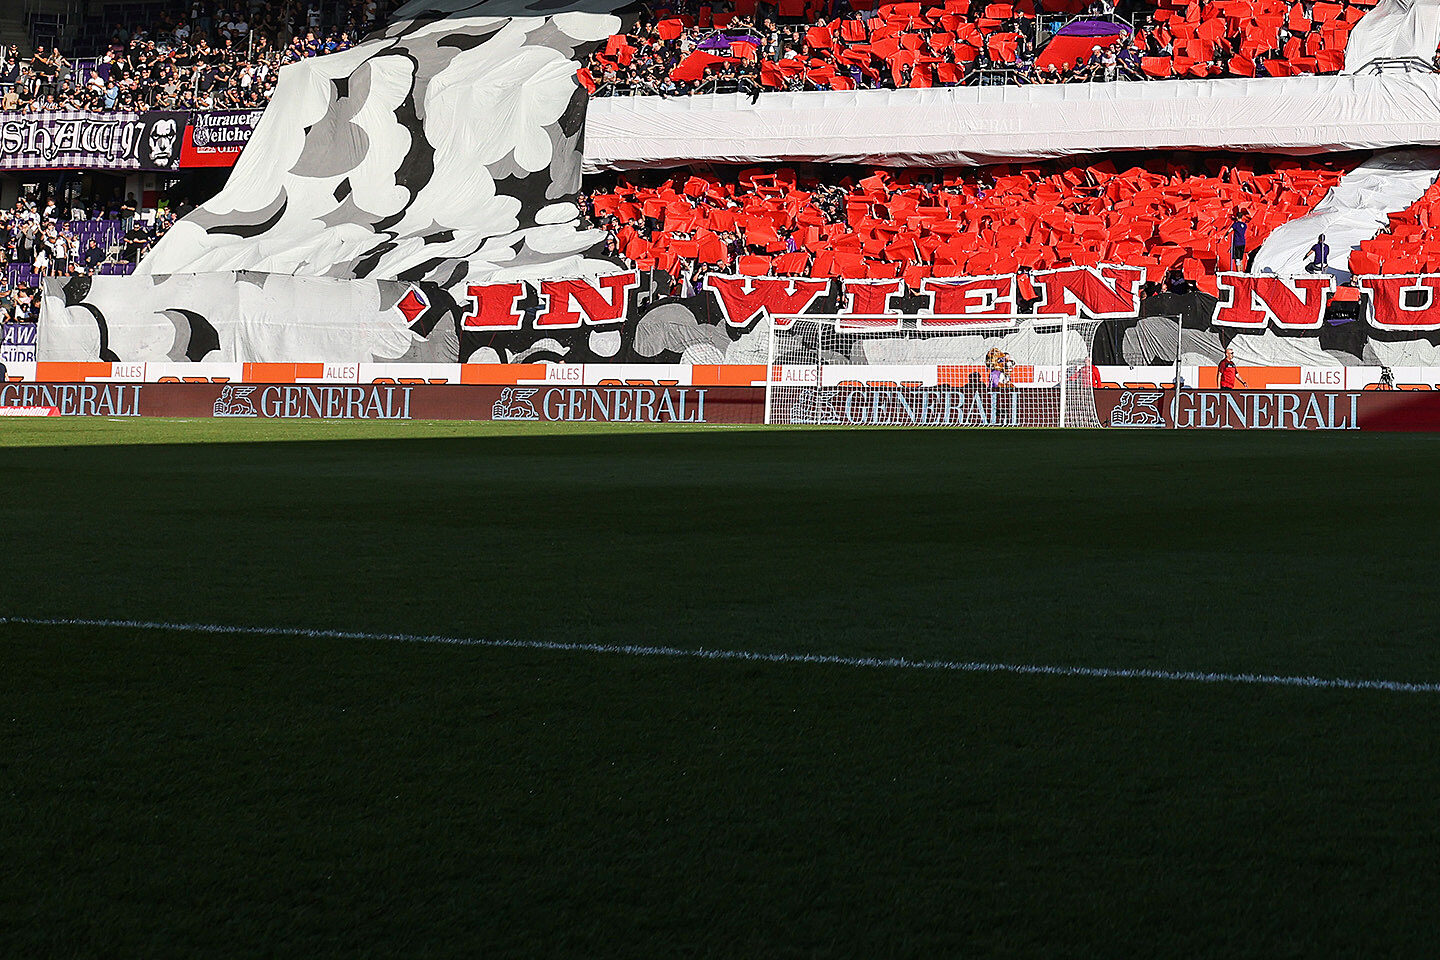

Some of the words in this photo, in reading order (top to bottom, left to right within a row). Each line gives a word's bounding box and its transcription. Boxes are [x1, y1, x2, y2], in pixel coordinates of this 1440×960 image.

[461, 270, 640, 330] IN
[703, 265, 1147, 332] WIEN
[115, 366, 142, 378] ALLES
[326, 367, 355, 379] ALLES
[550, 368, 580, 380] ALLES
[786, 369, 817, 381] ALLES
[1304, 371, 1341, 384] ALLES
[1, 384, 143, 417] GENERALI
[260, 386, 414, 420] GENERALI
[543, 388, 708, 423] GENERALI
[845, 390, 1022, 426] GENERALI
[1169, 392, 1361, 430] GENERALI
